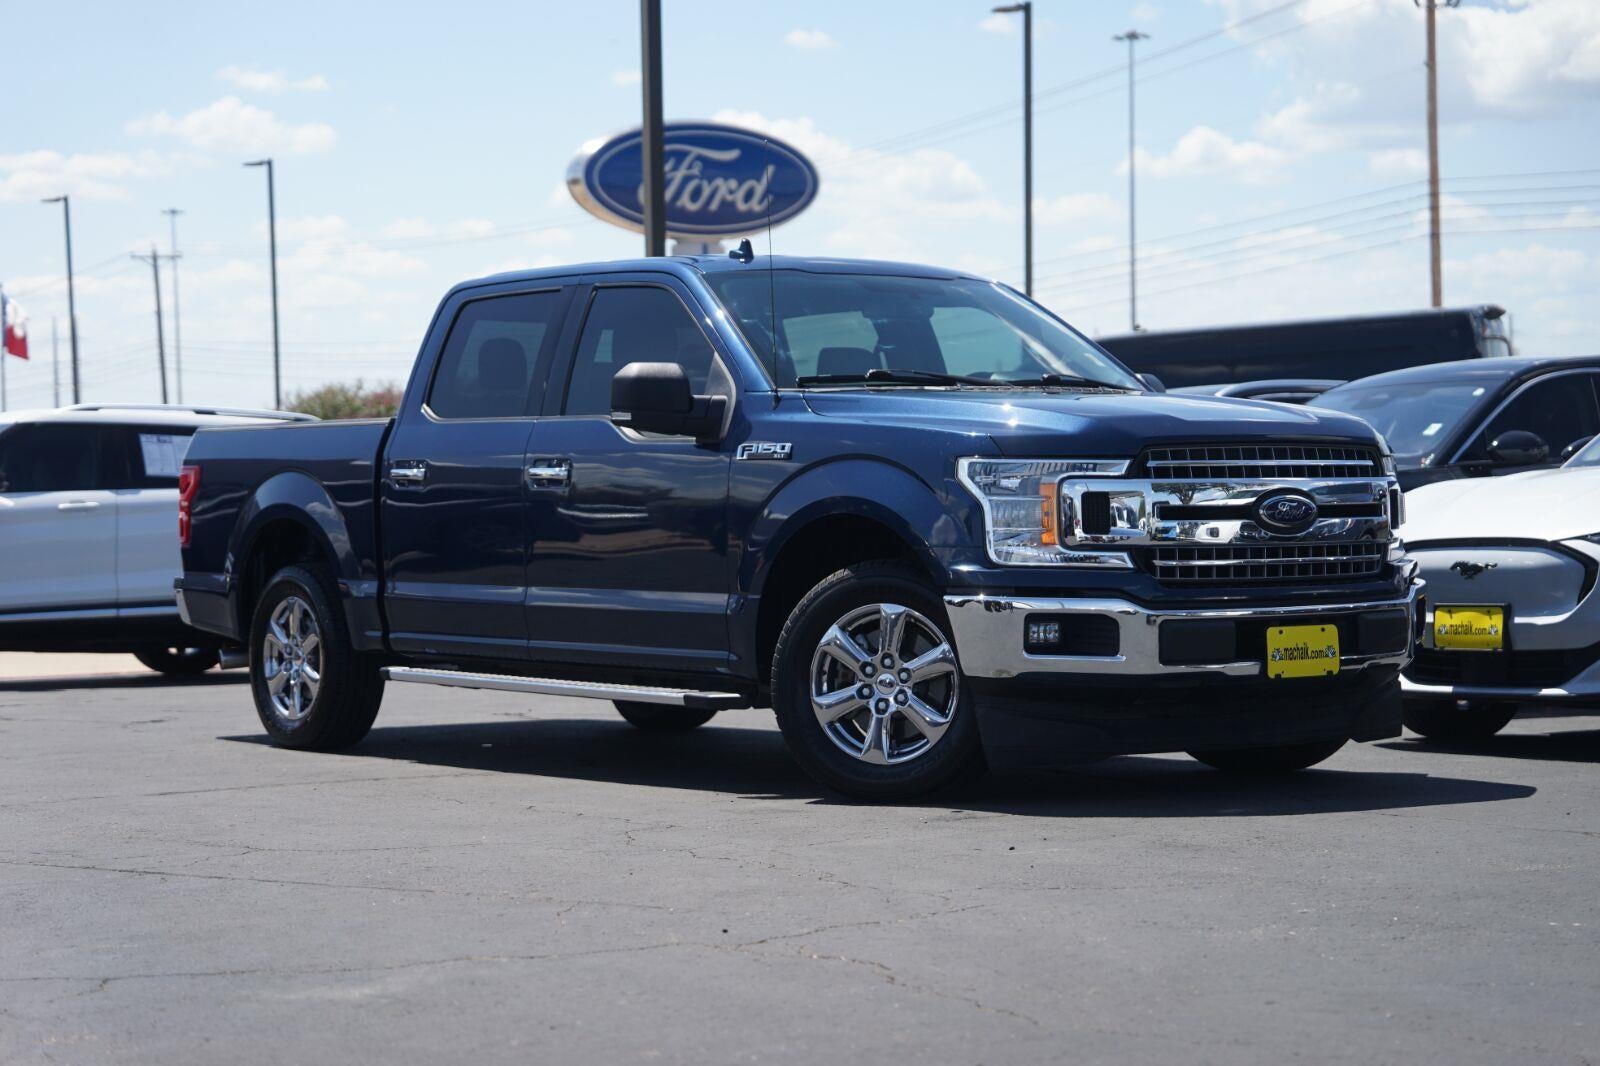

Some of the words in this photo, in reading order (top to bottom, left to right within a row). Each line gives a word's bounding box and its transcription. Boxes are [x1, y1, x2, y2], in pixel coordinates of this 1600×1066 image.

[637, 143, 776, 213] Ford
[1276, 501, 1306, 519] Ford
[1449, 620, 1488, 636] machaik.com
[1284, 642, 1325, 661] machaik.com
